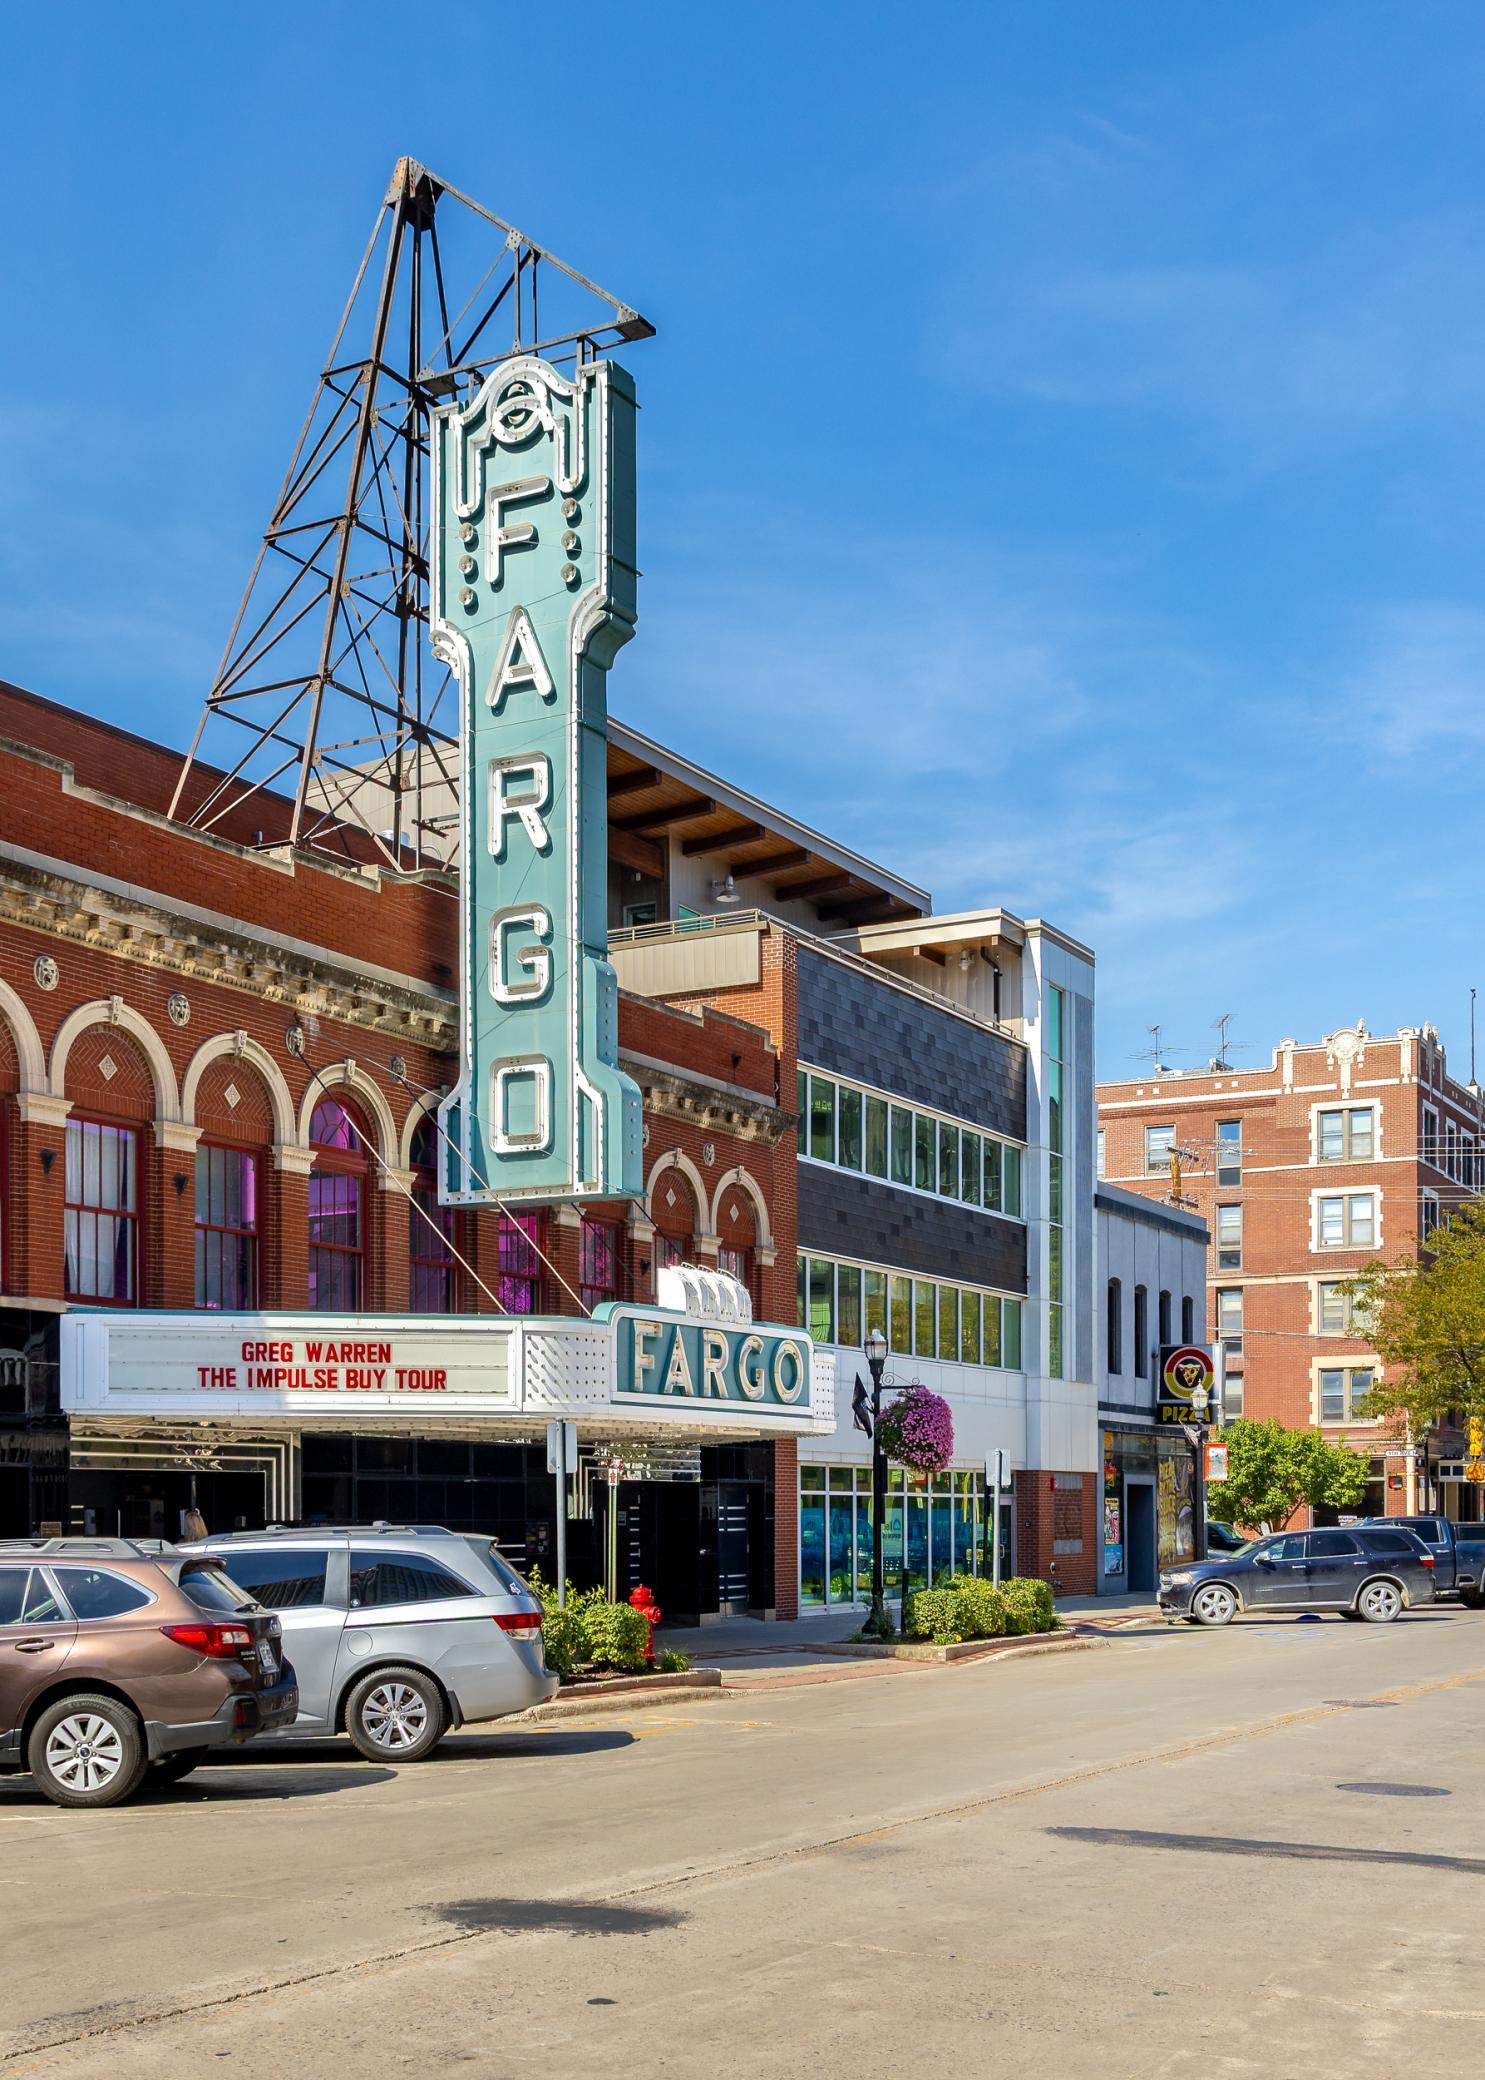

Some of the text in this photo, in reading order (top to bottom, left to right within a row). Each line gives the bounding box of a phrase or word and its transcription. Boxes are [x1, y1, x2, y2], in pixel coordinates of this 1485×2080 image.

[484, 475, 554, 1154] FARGO
[197, 1367, 446, 1390] THE IMPULSE BUY TOUR
[241, 1341, 391, 1364] GREG WARREN
[633, 1319, 804, 1404] FARGO
